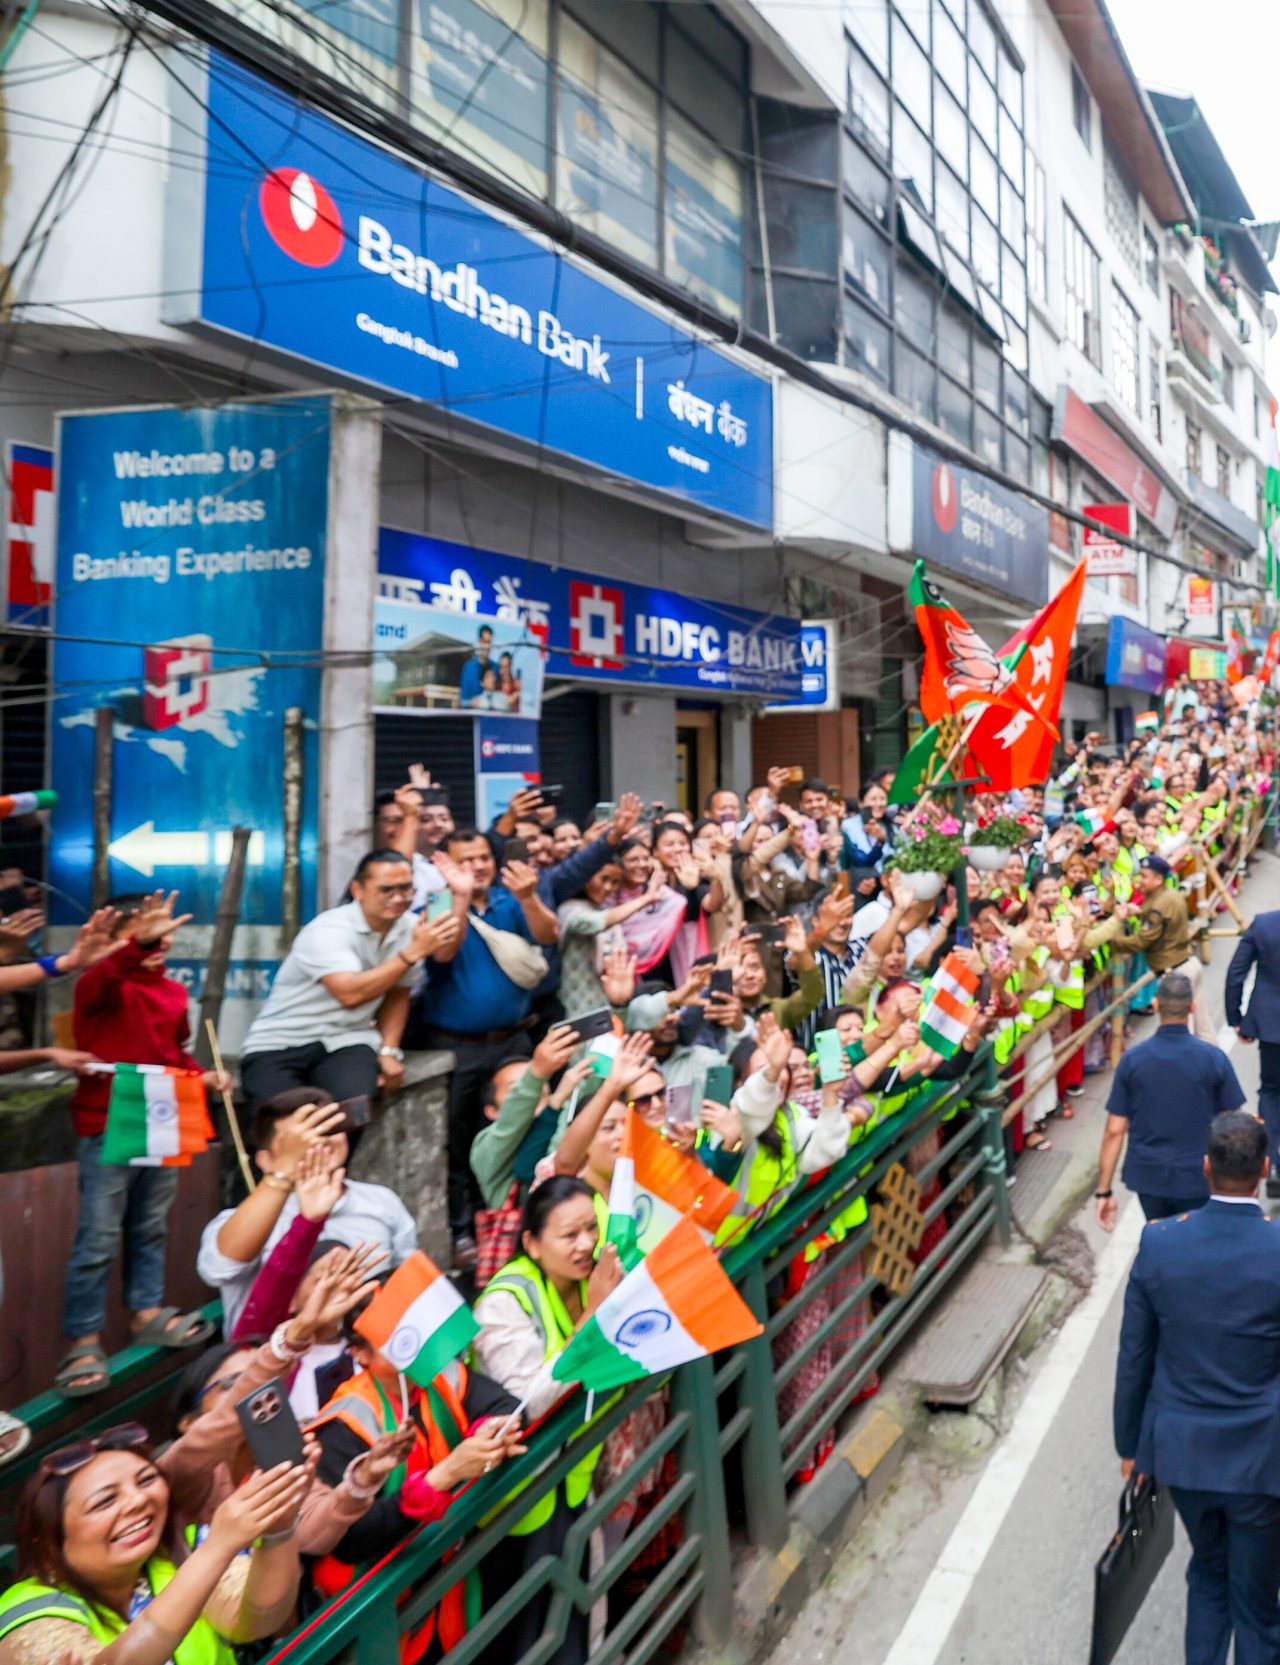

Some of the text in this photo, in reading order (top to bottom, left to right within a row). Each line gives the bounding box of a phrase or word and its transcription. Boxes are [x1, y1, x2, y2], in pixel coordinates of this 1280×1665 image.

[359, 215, 611, 384] Bandhan Bank
[113, 446, 276, 479] Welcome to a
[120, 496, 266, 528] World Class
[73, 544, 312, 583] Banking Experience
[1091, 547, 1124, 559] ATM
[635, 614, 721, 662] HDFC
[727, 630, 798, 674] BANK
